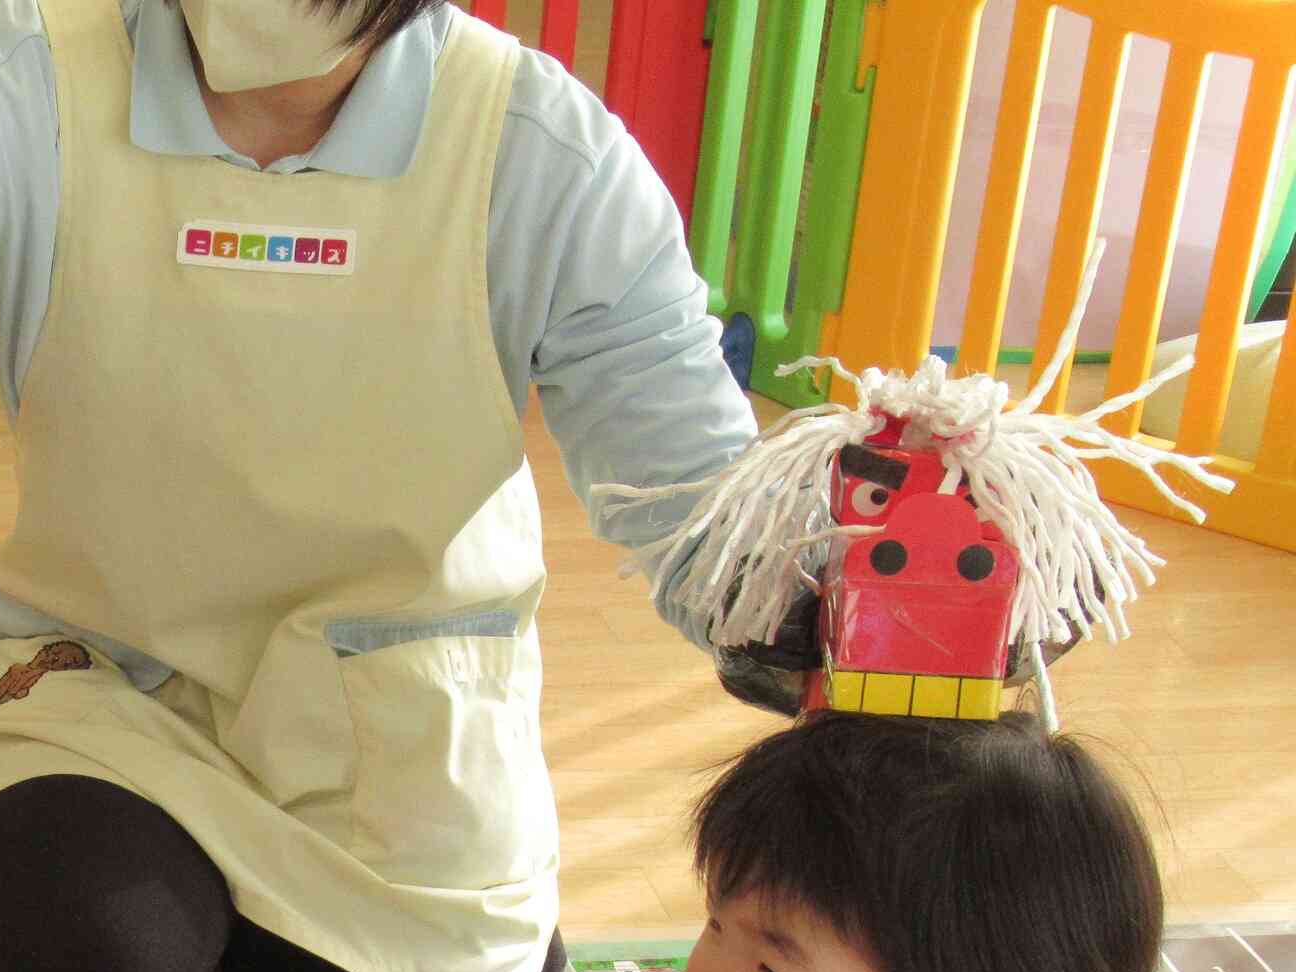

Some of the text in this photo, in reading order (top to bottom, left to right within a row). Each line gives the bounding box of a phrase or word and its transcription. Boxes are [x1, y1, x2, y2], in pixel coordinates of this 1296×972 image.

[190, 236, 347, 264] ニチイキッズ
